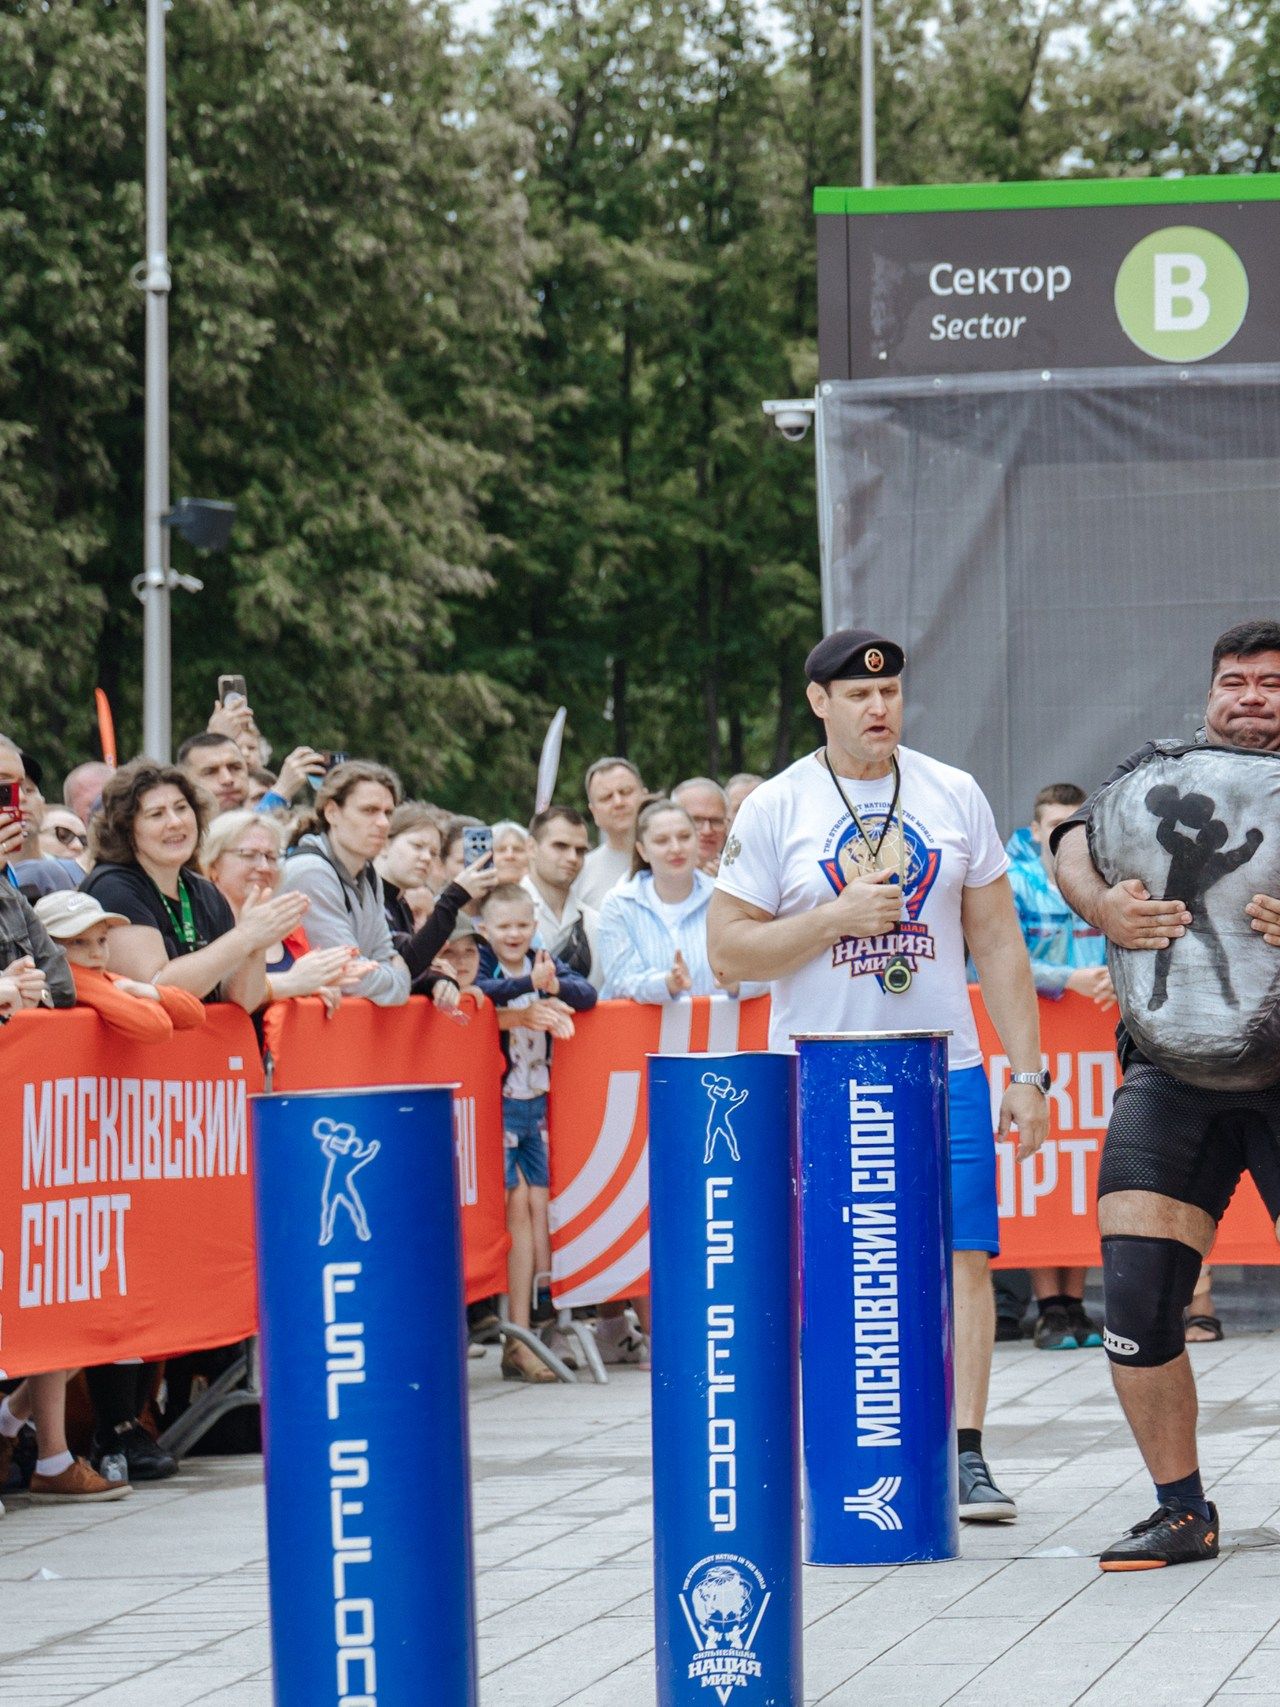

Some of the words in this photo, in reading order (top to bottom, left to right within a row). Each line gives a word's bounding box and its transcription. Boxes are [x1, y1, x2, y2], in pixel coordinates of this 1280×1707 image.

[928, 262, 1072, 301] Сектор
[928, 313, 1027, 342] Sector
[833, 934, 934, 965] НАЦИЯ
[21, 1055, 248, 1191] МОСКОВСКИЙ
[849, 1078, 896, 1193] СПОРТ
[18, 1193, 131, 1309] СПОРТ
[842, 1202, 902, 1448] МОСКОВСКИЙ
[687, 1657, 762, 1679] НАЦИЯ
[701, 1673, 748, 1688] МИРА
